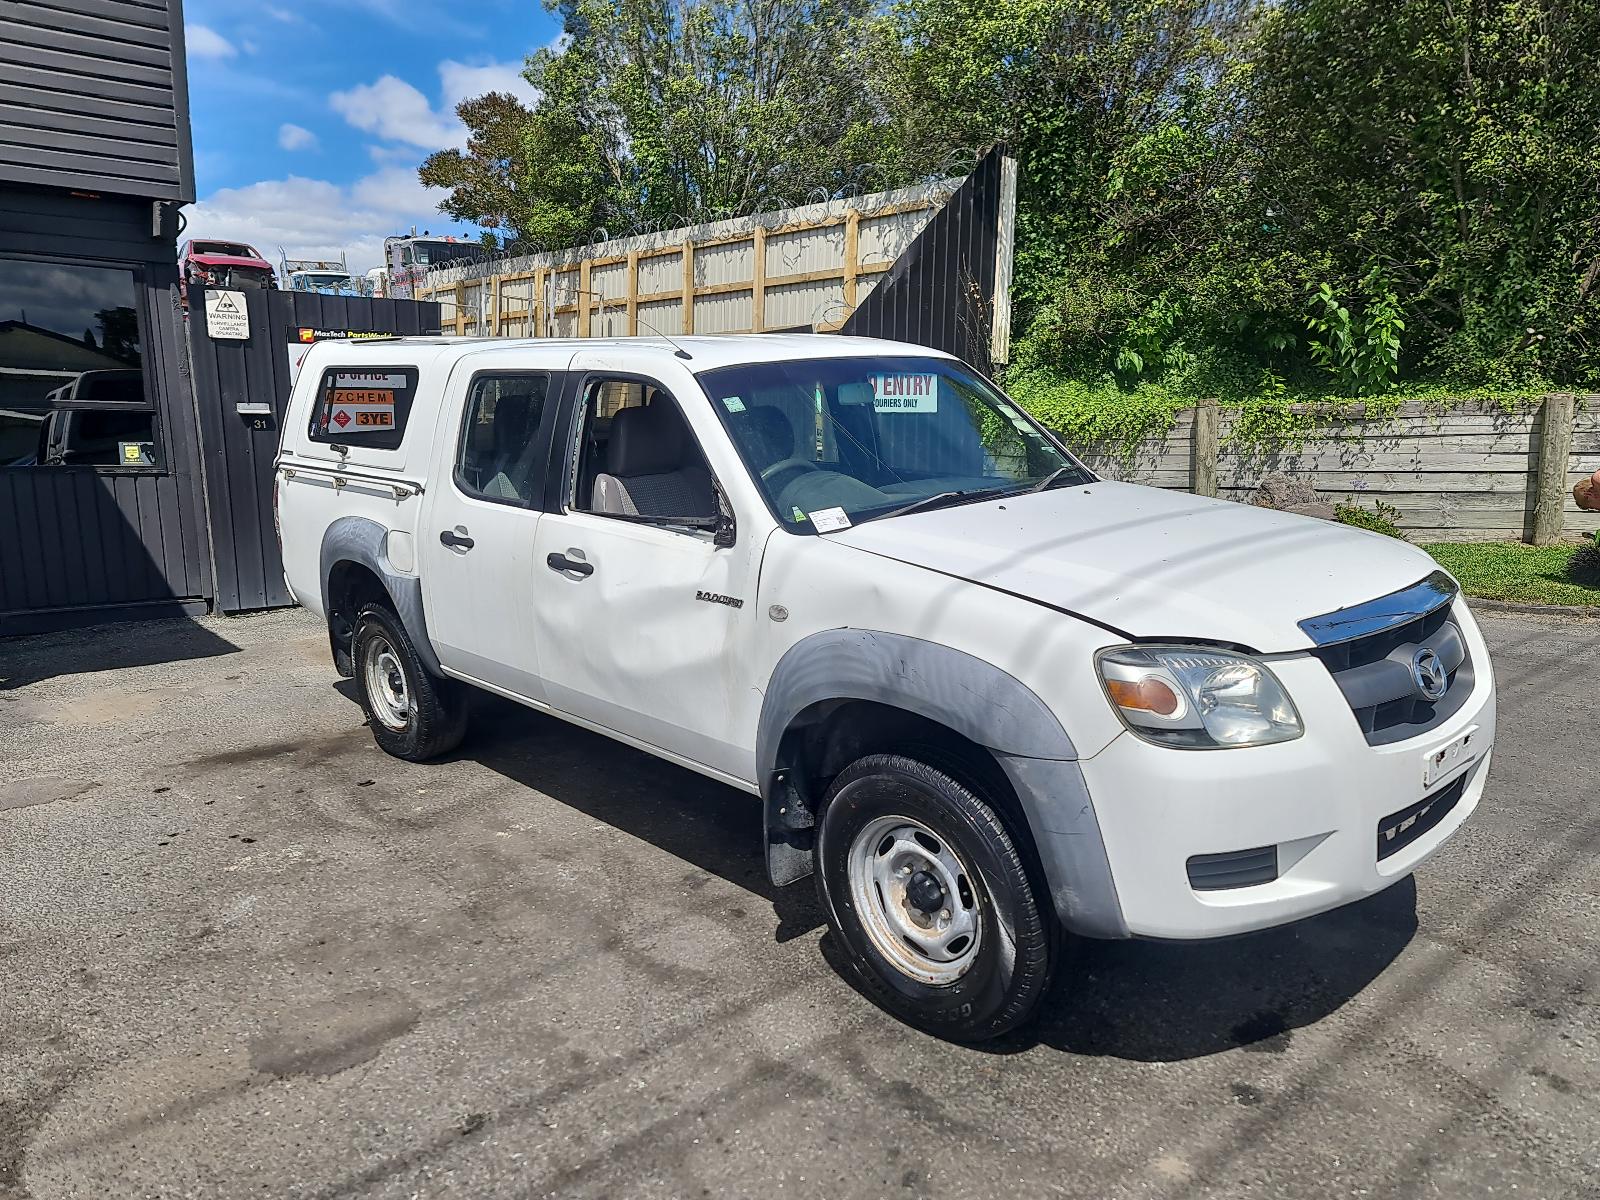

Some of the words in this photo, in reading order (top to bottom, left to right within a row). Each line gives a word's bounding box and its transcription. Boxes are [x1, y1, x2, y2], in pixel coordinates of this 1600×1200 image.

[208, 313, 247, 321] WARNING
[314, 330, 346, 338] MaxTech
[883, 374, 933, 396] ENTRY
[874, 398, 902, 408] OURIERS
[903, 398, 919, 408] ONLY
[254, 419, 267, 429] 31
[360, 413, 389, 425] 3YE
